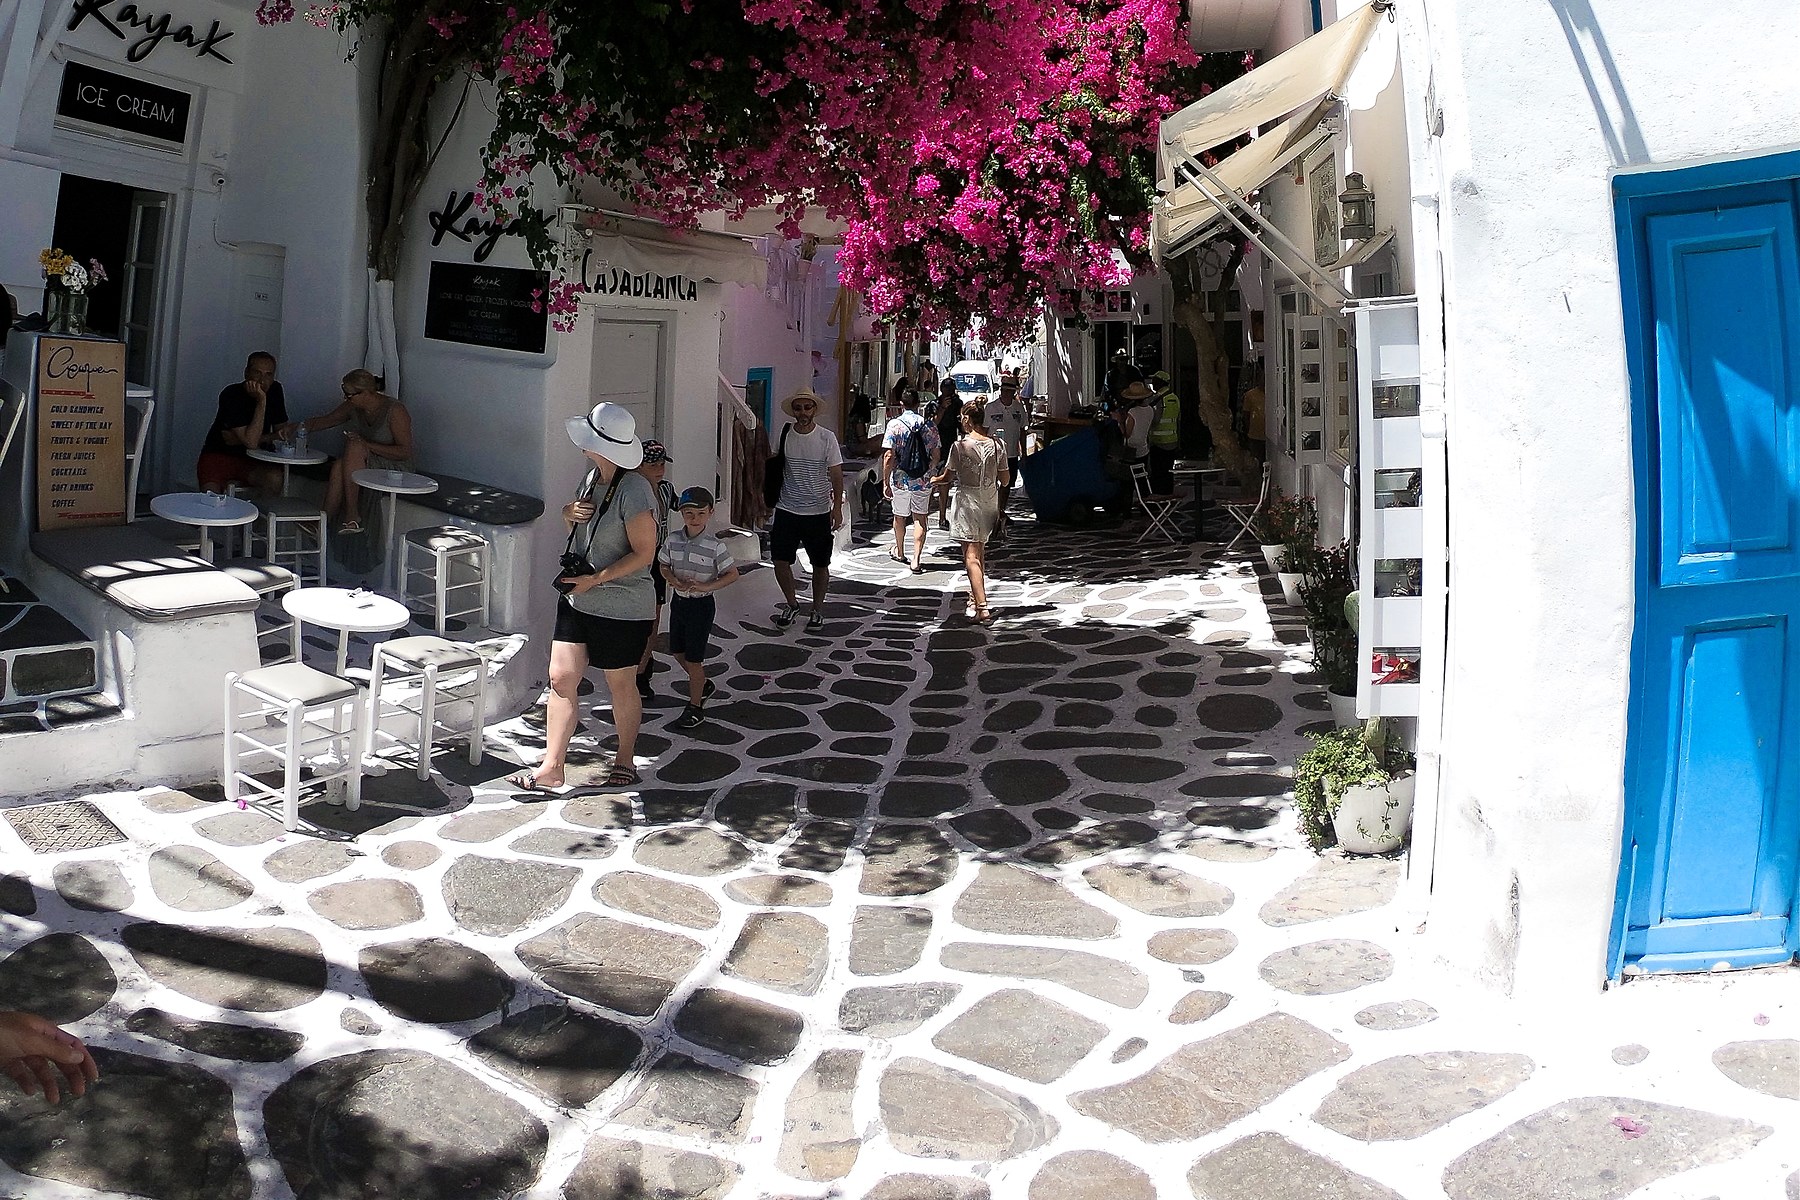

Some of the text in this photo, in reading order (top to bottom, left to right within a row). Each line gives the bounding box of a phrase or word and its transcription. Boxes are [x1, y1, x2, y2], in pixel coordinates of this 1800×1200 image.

[77, 82, 176, 125] ICE CREAM
[473, 275, 501, 290] Kayak
[510, 299, 533, 308] YOGUR
[51, 405, 68, 413] COLD
[51, 421, 113, 430] SWEET OF THE DAY
[51, 436, 74, 445] FRUITS
[51, 452, 96, 460] FRESH JUICES
[51, 467, 87, 476] COCKTAILS
[51, 483, 95, 491] SOFT DRINKS
[51, 499, 76, 508] COFFEE
